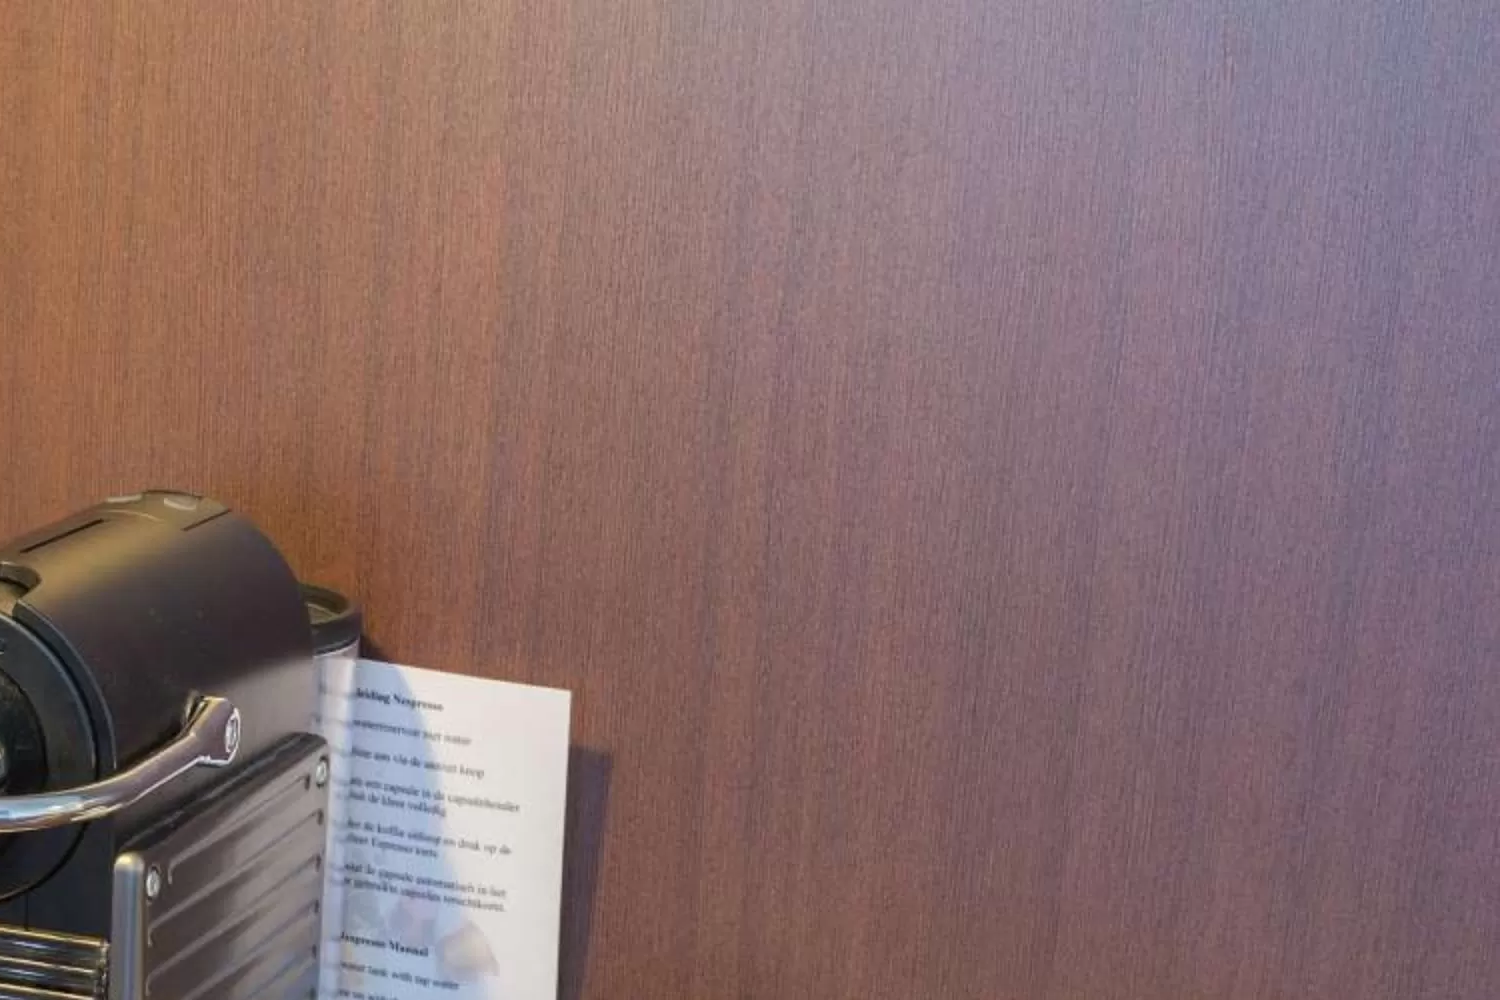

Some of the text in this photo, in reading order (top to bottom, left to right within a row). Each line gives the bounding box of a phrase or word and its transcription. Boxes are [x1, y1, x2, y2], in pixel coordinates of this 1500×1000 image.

[394, 694, 443, 711] Nespresso
[389, 939, 428, 957] Manual
[391, 970, 413, 983] with
